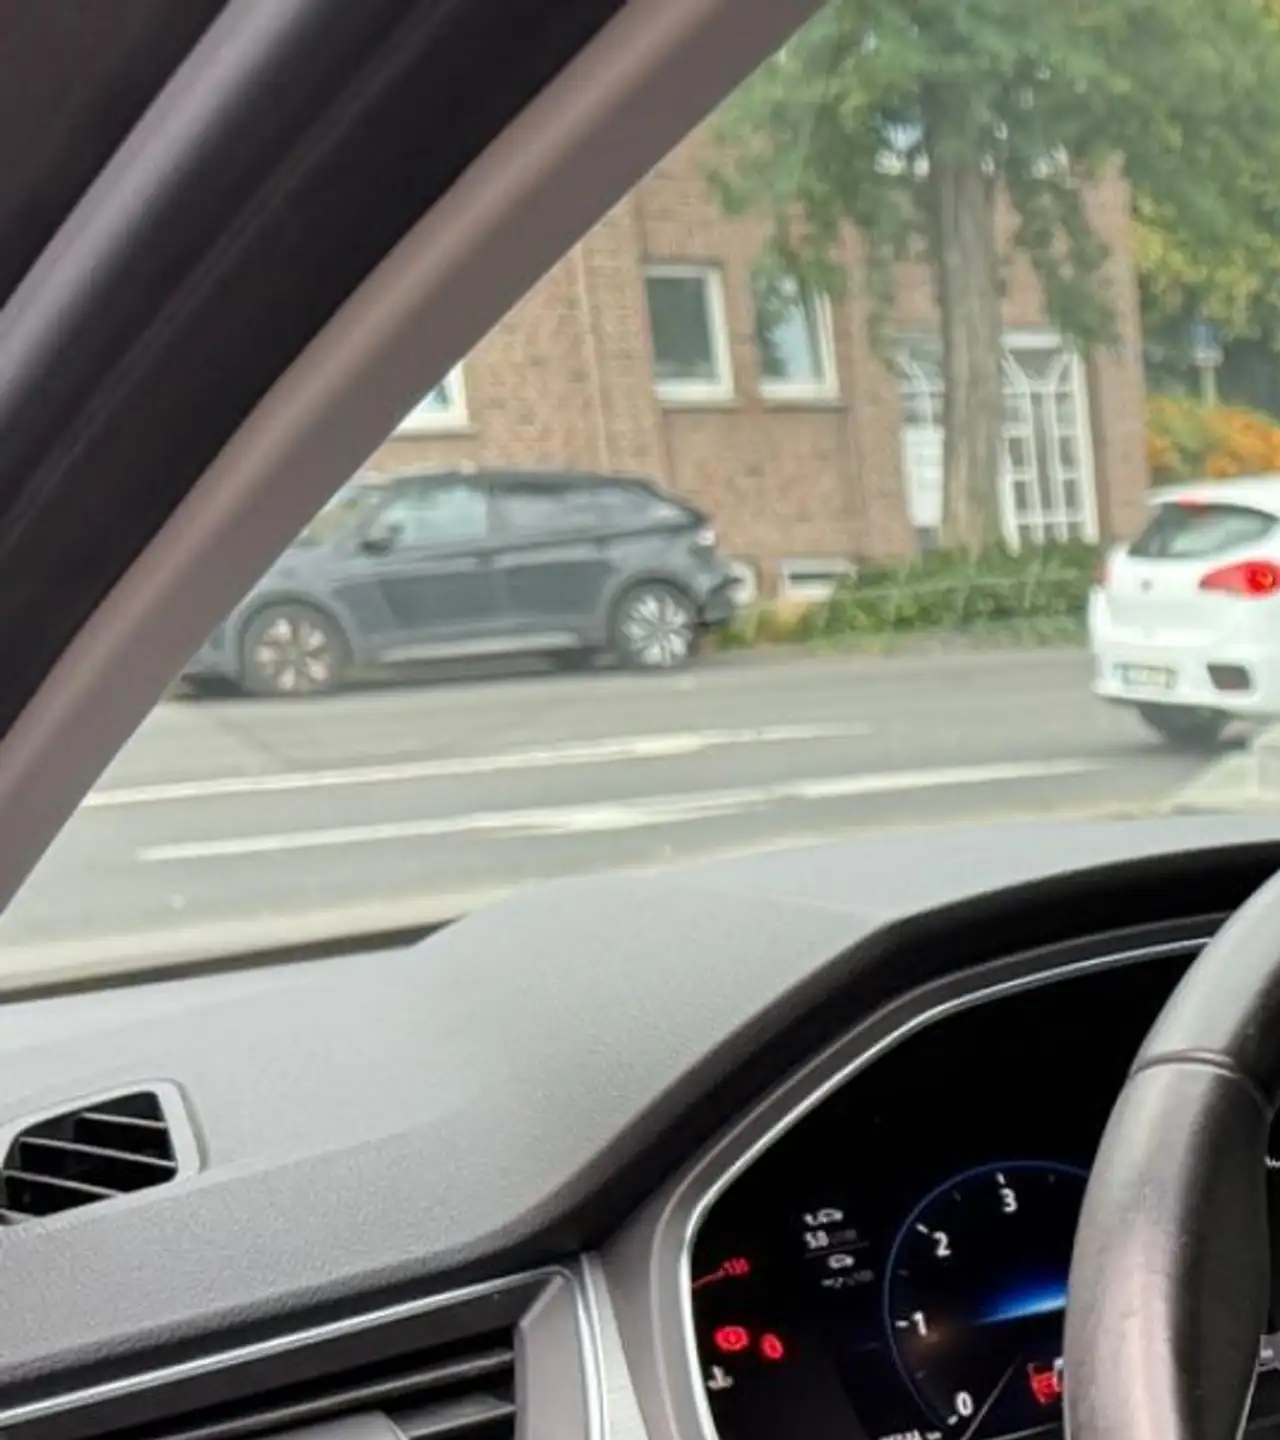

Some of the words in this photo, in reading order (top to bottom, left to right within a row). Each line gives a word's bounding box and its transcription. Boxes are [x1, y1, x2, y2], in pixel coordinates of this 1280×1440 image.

[1000, 1188, 1018, 1215] 3
[933, 1231, 951, 1258] 2
[912, 1311, 928, 1336] 1
[954, 1391, 974, 1418] 0
